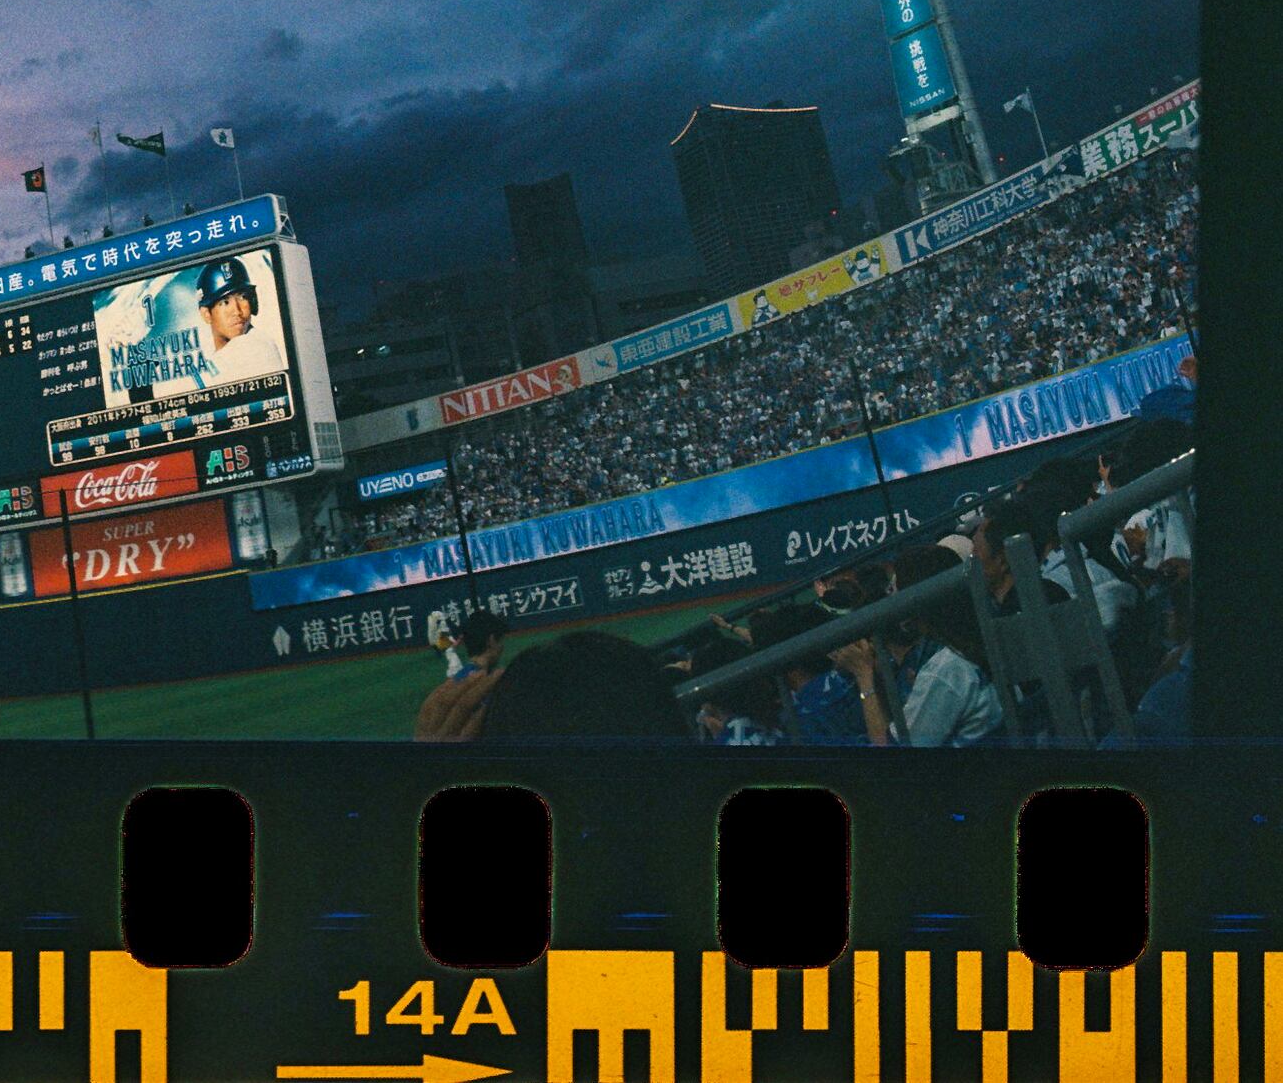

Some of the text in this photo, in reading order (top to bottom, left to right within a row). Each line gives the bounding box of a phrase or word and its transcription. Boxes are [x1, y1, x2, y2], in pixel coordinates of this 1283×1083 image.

[909, 88, 946, 107] NISSAN
[932, 172, 1037, 240] 神奈川工科大学
[141, 294, 156, 328] 1
[110, 327, 200, 369] MASAYUKI
[619, 309, 730, 366] 東亜建設工業
[110, 352, 209, 394] KUWAHARA
[158, 396, 186, 411] 174cm
[188, 391, 211, 406] 80kg
[213, 381, 261, 400] 1993/7/21
[262, 376, 283, 392] (32)
[442, 369, 553, 423] NITTAN
[983, 371, 1113, 450] MASAYUKI
[74, 459, 160, 509] Coca-Cola
[359, 471, 415, 499] UYENO
[102, 520, 156, 542] SUPER
[422, 526, 535, 579] MASAYUKI
[540, 497, 667, 557] KUWAHARA
[660, 543, 758, 590] 大洋建設
[513, 580, 579, 615] シウマイ
[301, 604, 414, 654] 横浜銀行
[338, 977, 517, 1036] 14A
